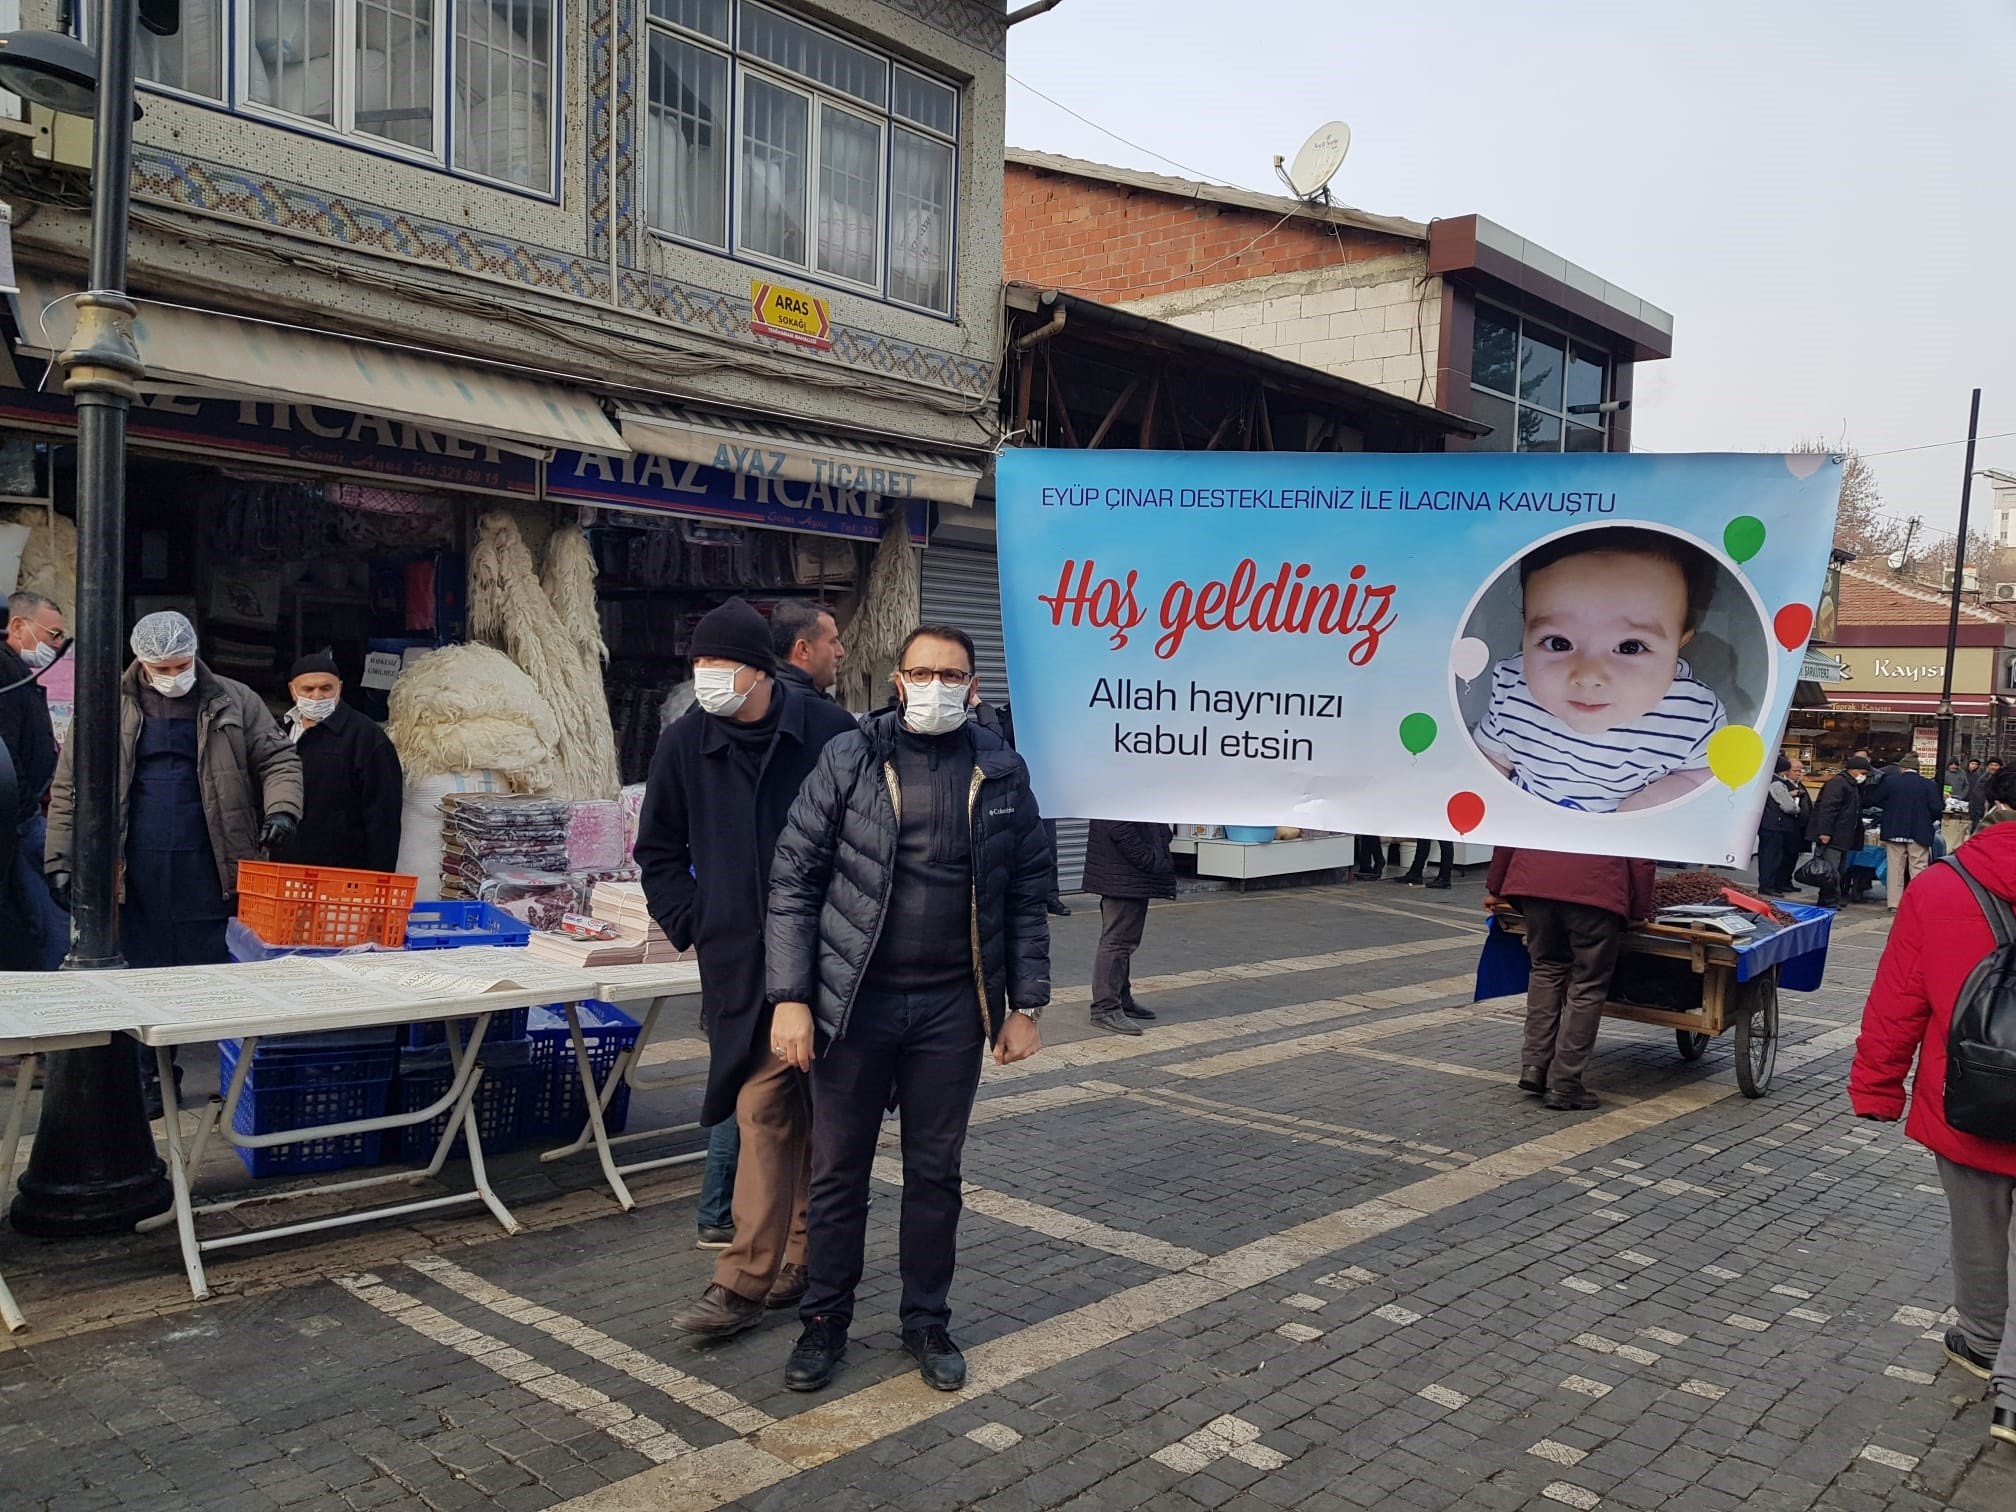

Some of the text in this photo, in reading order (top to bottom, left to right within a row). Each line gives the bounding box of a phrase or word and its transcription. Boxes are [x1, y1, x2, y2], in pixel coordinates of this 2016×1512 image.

[775, 294, 809, 316] ARAS
[778, 315, 807, 332] SOKAĞI
[712, 442, 917, 499] AYAZ TİCARET
[1041, 484, 1616, 516] EYÜP ÇINAR DESTEKLERİNİZ İLE İLACINA KAVUŞTU
[1037, 558, 1399, 667] Hoş geldiniz
[1874, 658, 1945, 683] Kayısı
[1088, 677, 1343, 721] Allah hayrınızı
[1114, 723, 1313, 761] kabul etsin
